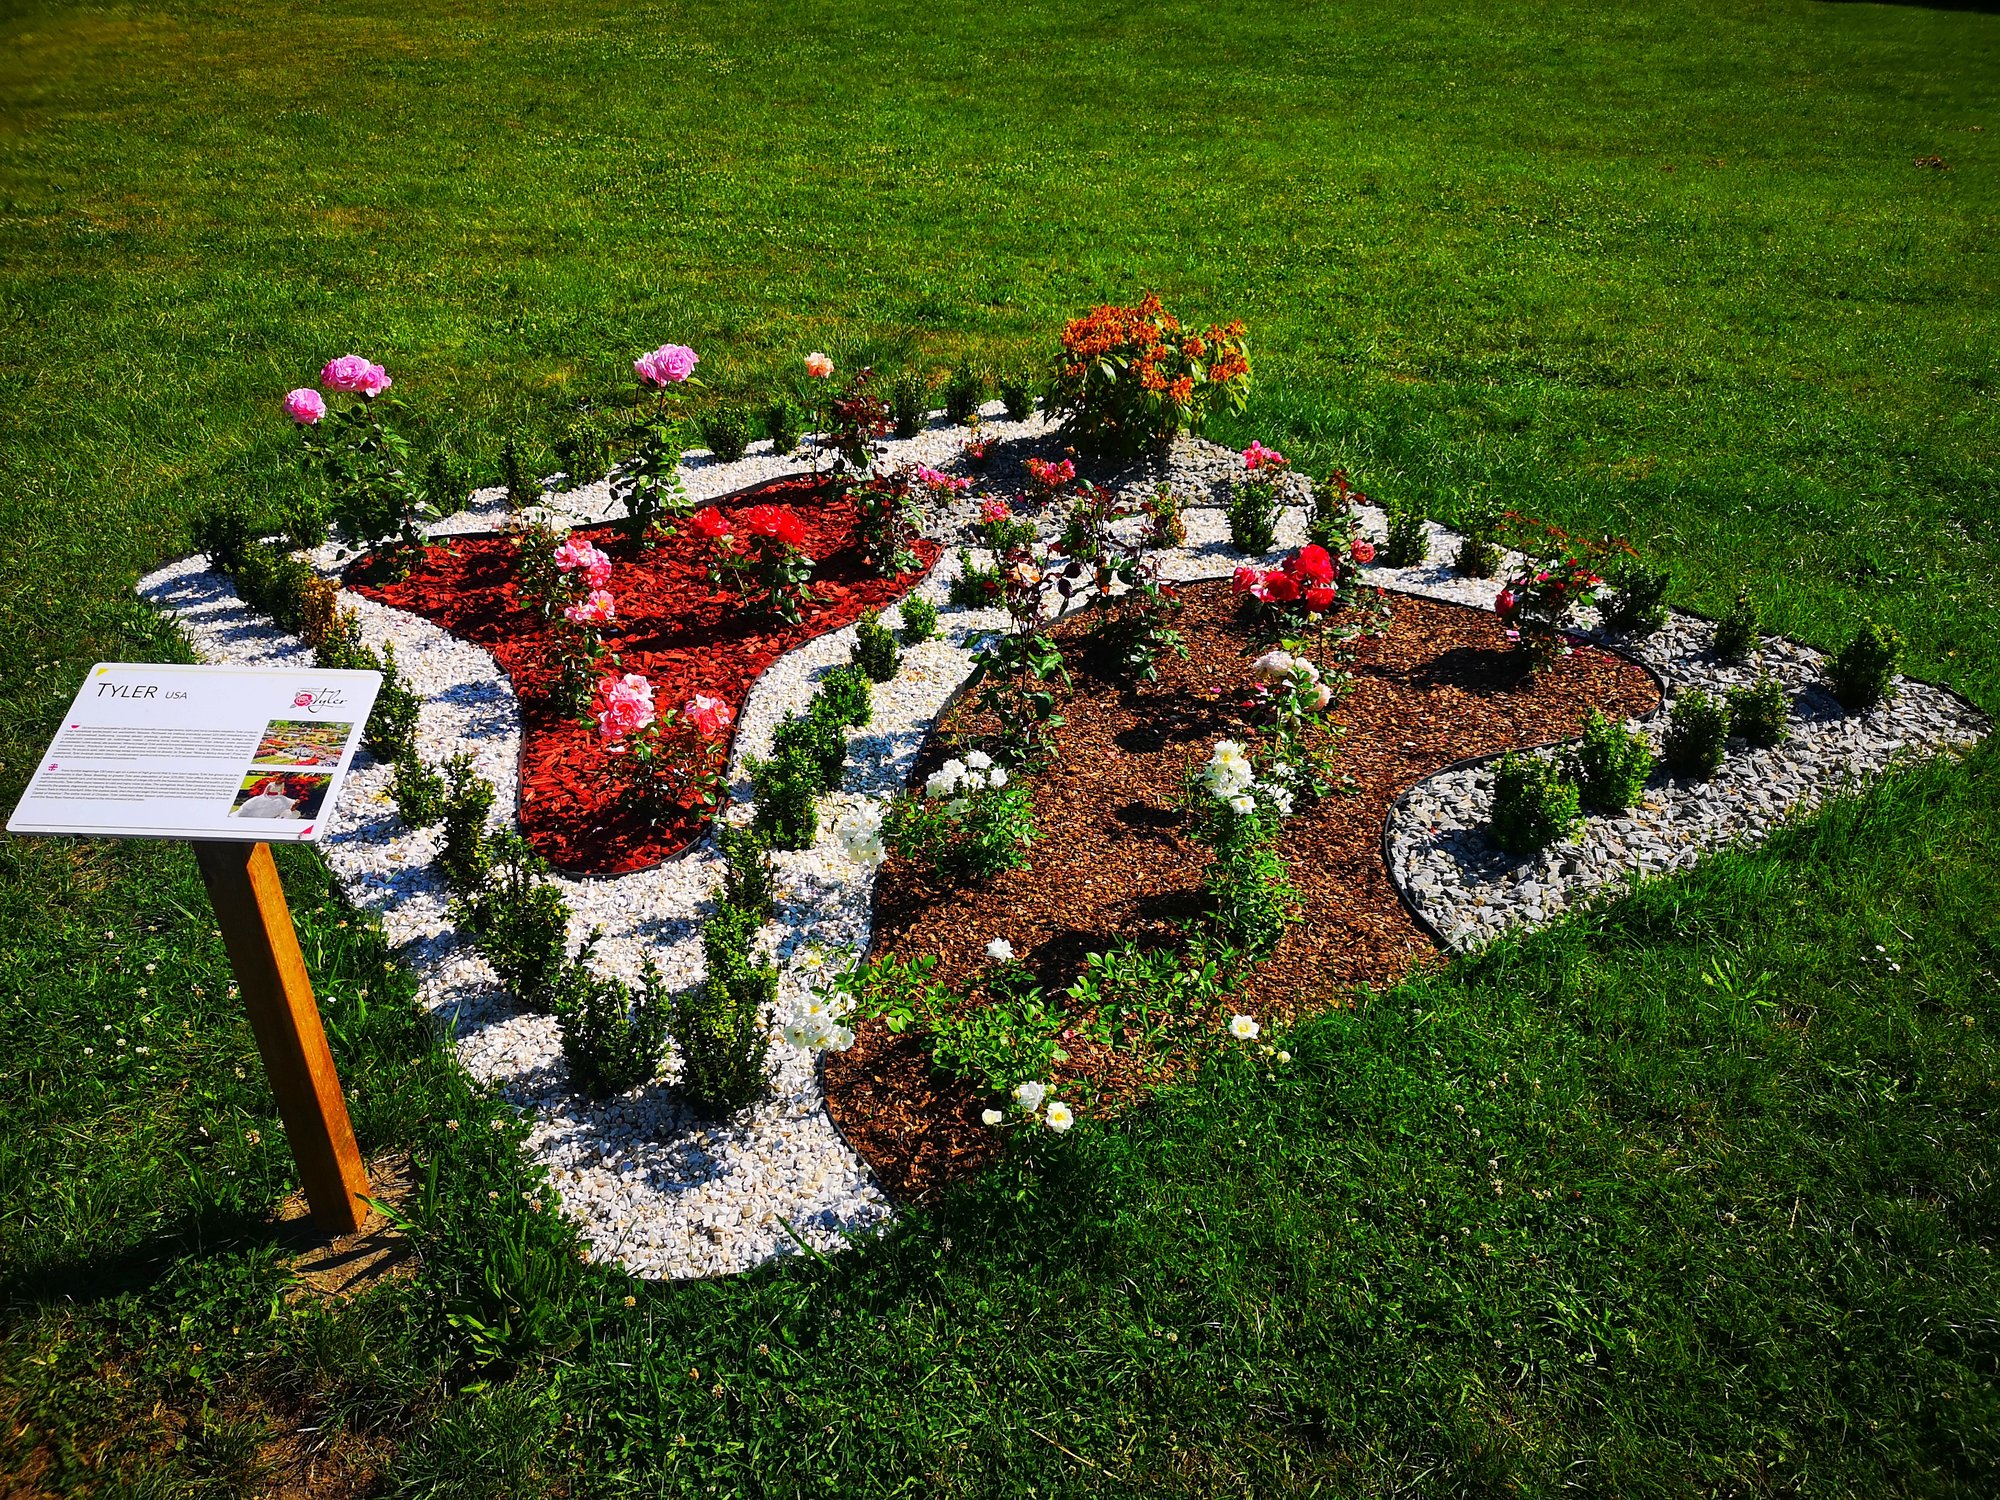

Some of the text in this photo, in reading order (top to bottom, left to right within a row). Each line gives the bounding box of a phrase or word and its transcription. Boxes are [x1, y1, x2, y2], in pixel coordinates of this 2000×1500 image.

[97, 682, 188, 700] TYLER USA
[300, 687, 348, 713] Tyler
